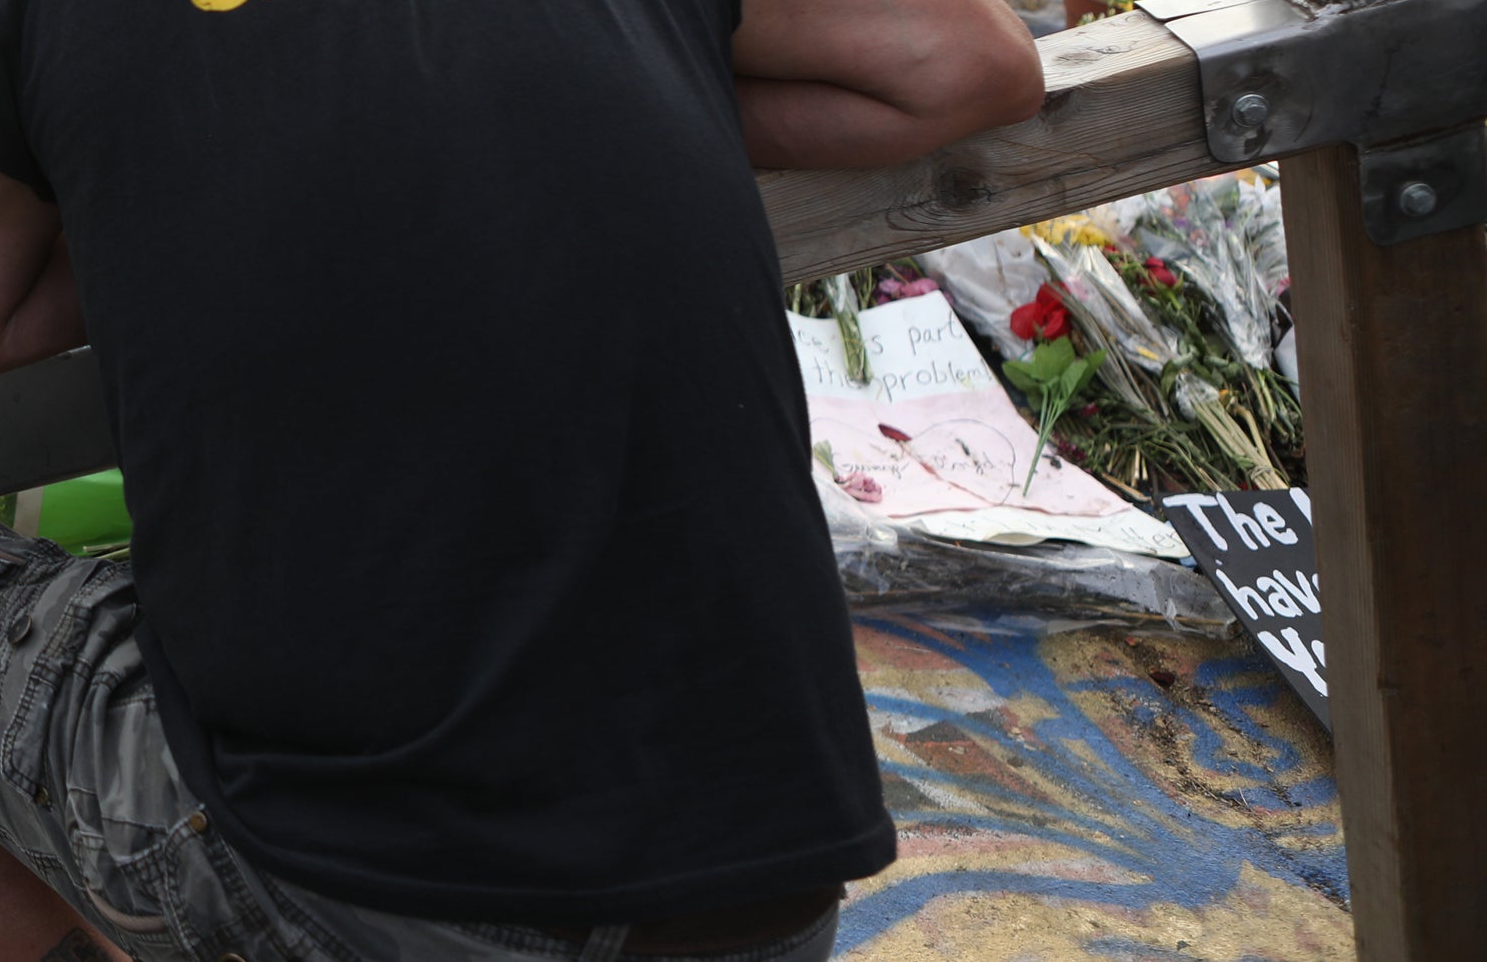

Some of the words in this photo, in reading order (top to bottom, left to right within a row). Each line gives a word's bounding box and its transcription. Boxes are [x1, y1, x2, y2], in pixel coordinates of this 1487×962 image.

[908, 311, 964, 356] part
[882, 358, 993, 403] problem!
[1162, 492, 1299, 552] The
